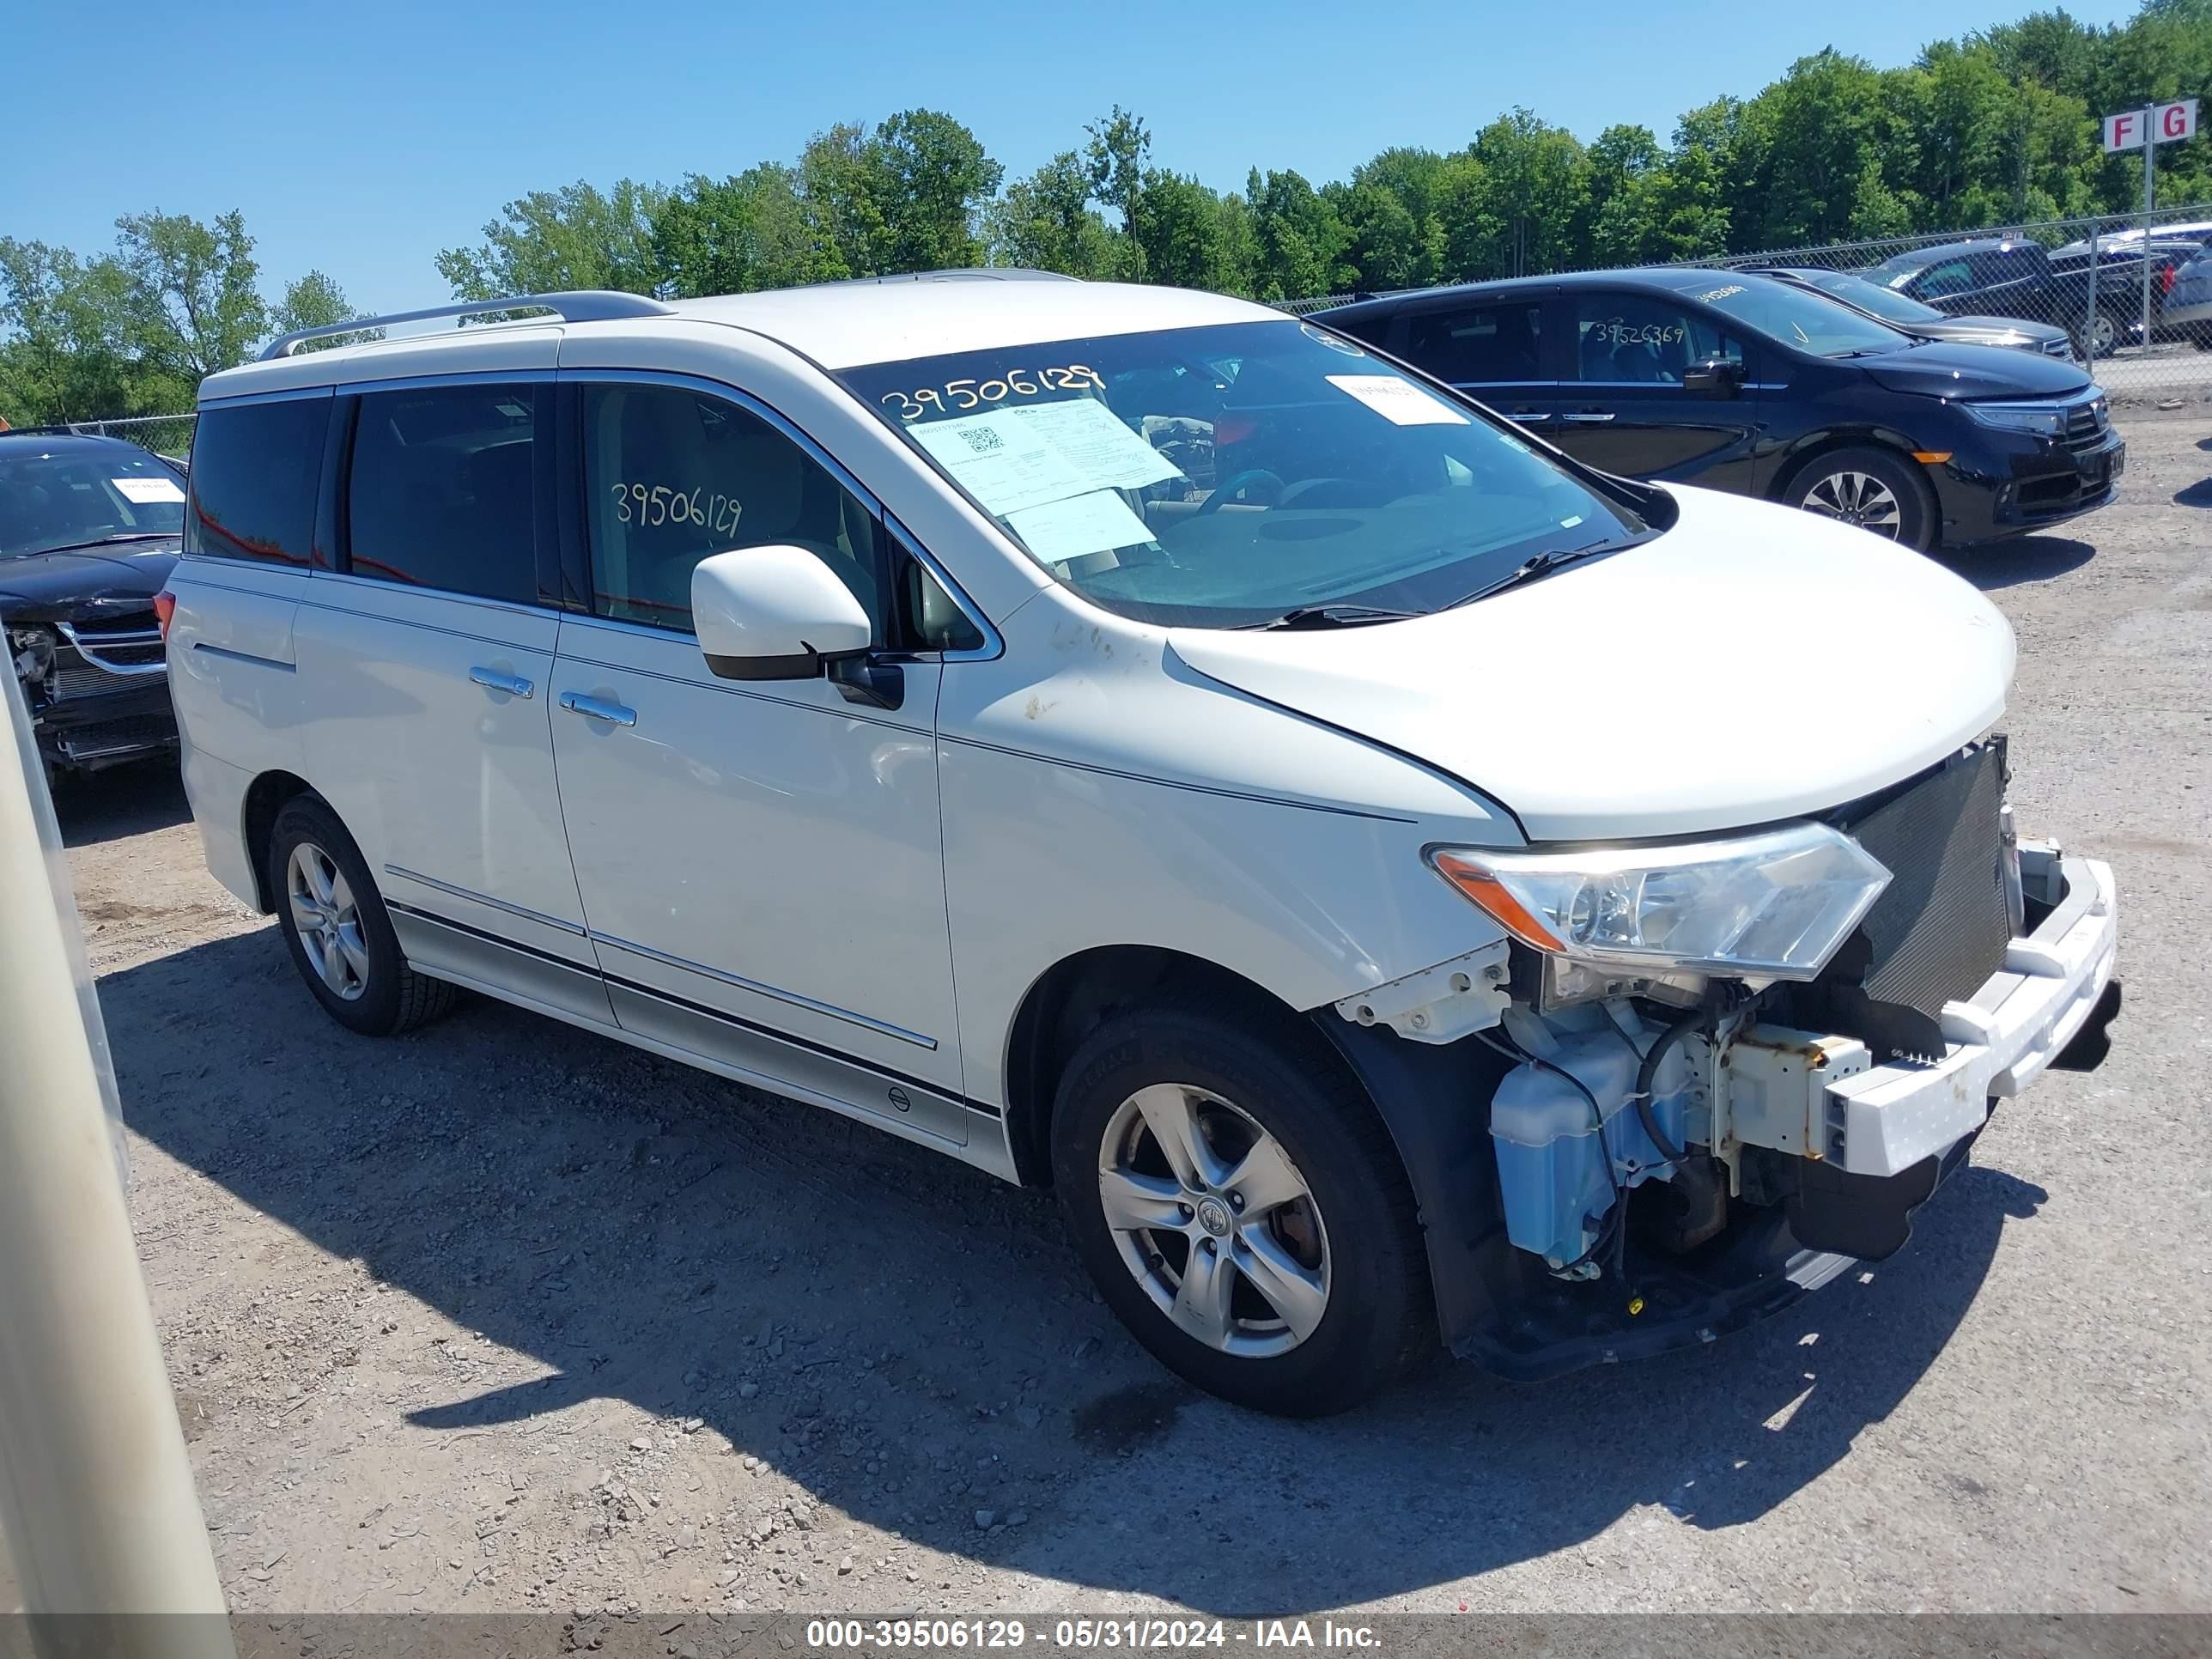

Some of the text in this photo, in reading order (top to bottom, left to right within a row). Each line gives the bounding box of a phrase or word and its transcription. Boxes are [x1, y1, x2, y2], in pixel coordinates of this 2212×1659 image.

[2114, 116, 2133, 148] F
[2163, 106, 2185, 137] G
[1596, 324, 1684, 345] 39526369
[881, 364, 1107, 420] 39506129
[611, 483, 743, 538] 39506129
